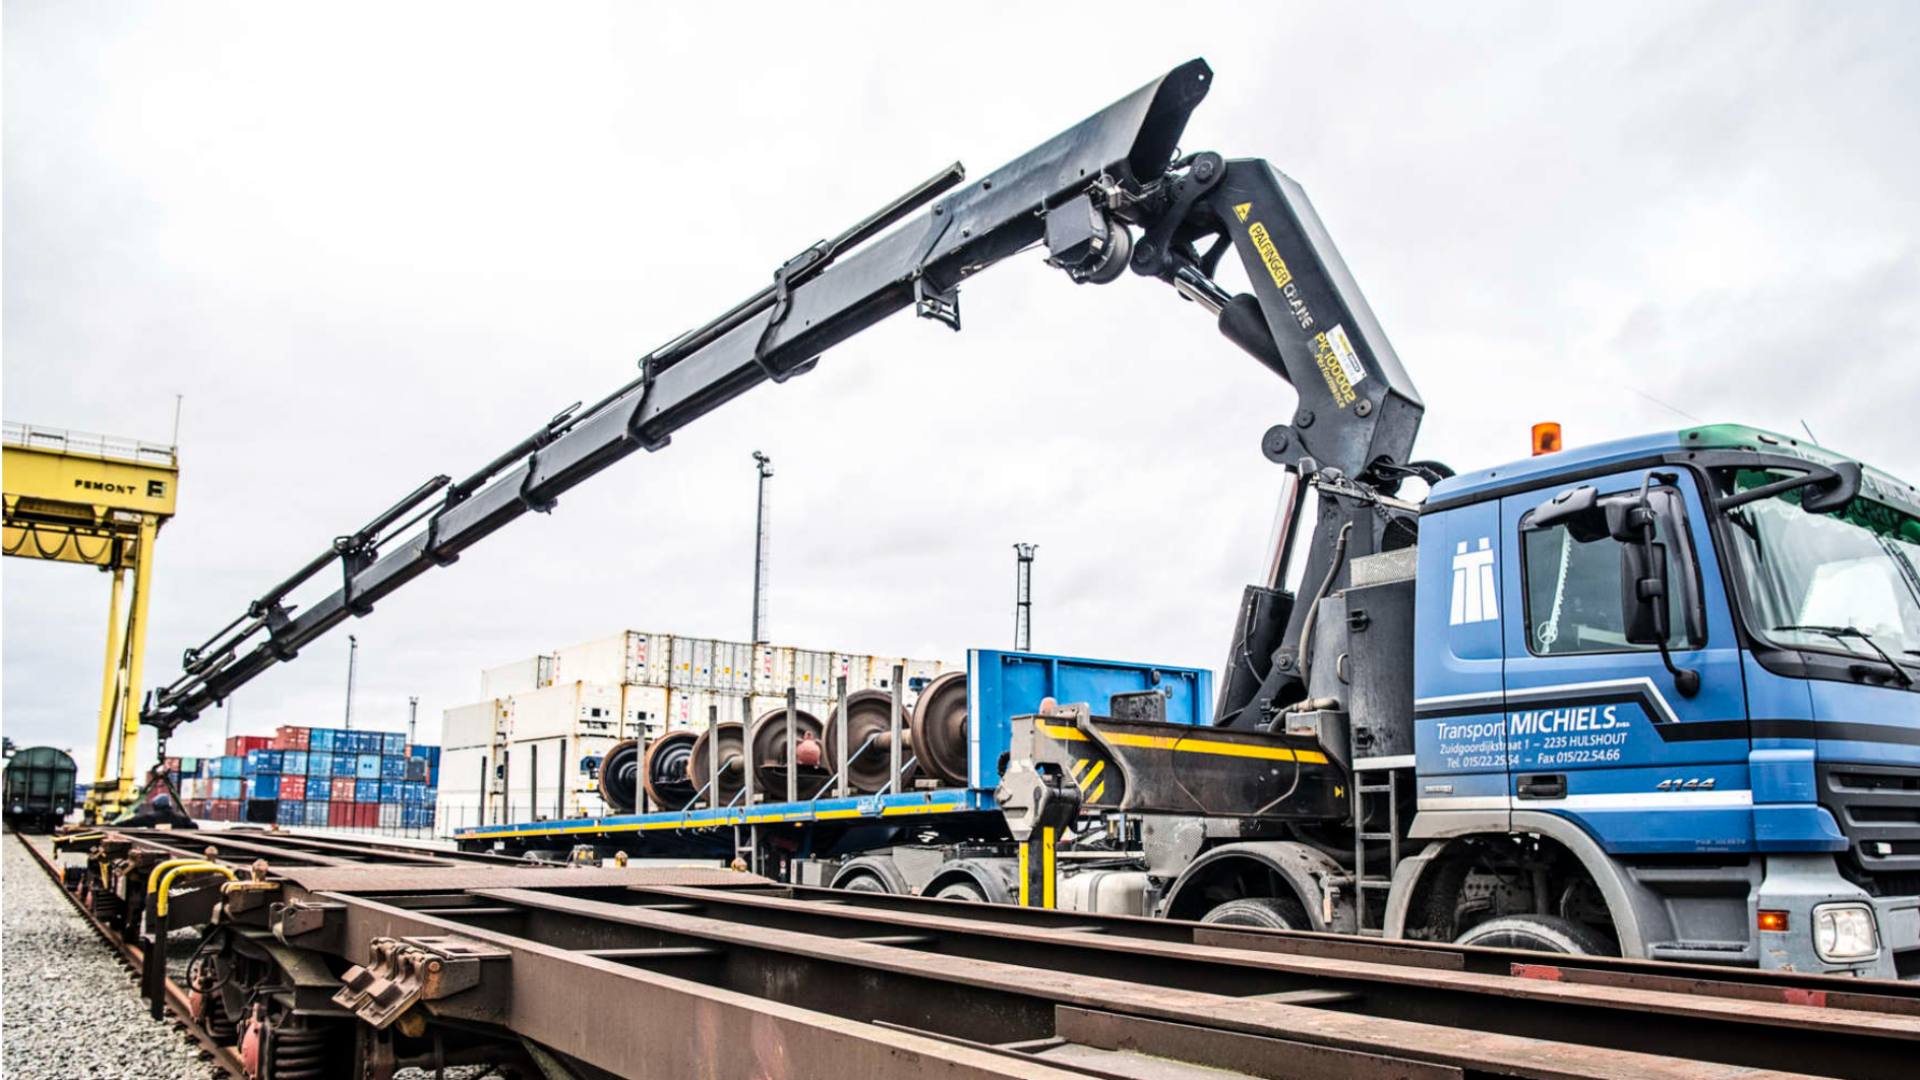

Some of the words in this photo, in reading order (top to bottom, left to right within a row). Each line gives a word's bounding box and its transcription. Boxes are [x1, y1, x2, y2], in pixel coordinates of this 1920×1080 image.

[1252, 224, 1289, 285] PALFINGER
[1315, 332, 1330, 352] PK
[1324, 351, 1357, 404] 100002
[1436, 719, 1506, 742] Transport
[1511, 705, 1616, 735] MICHIELS
[1543, 736, 1567, 749] 2235
[1569, 731, 1627, 747] HULSHOUT
[1537, 752, 1555, 765] Fax
[1556, 748, 1620, 763] 015/22.54.66
[1655, 777, 1716, 792] 4144
